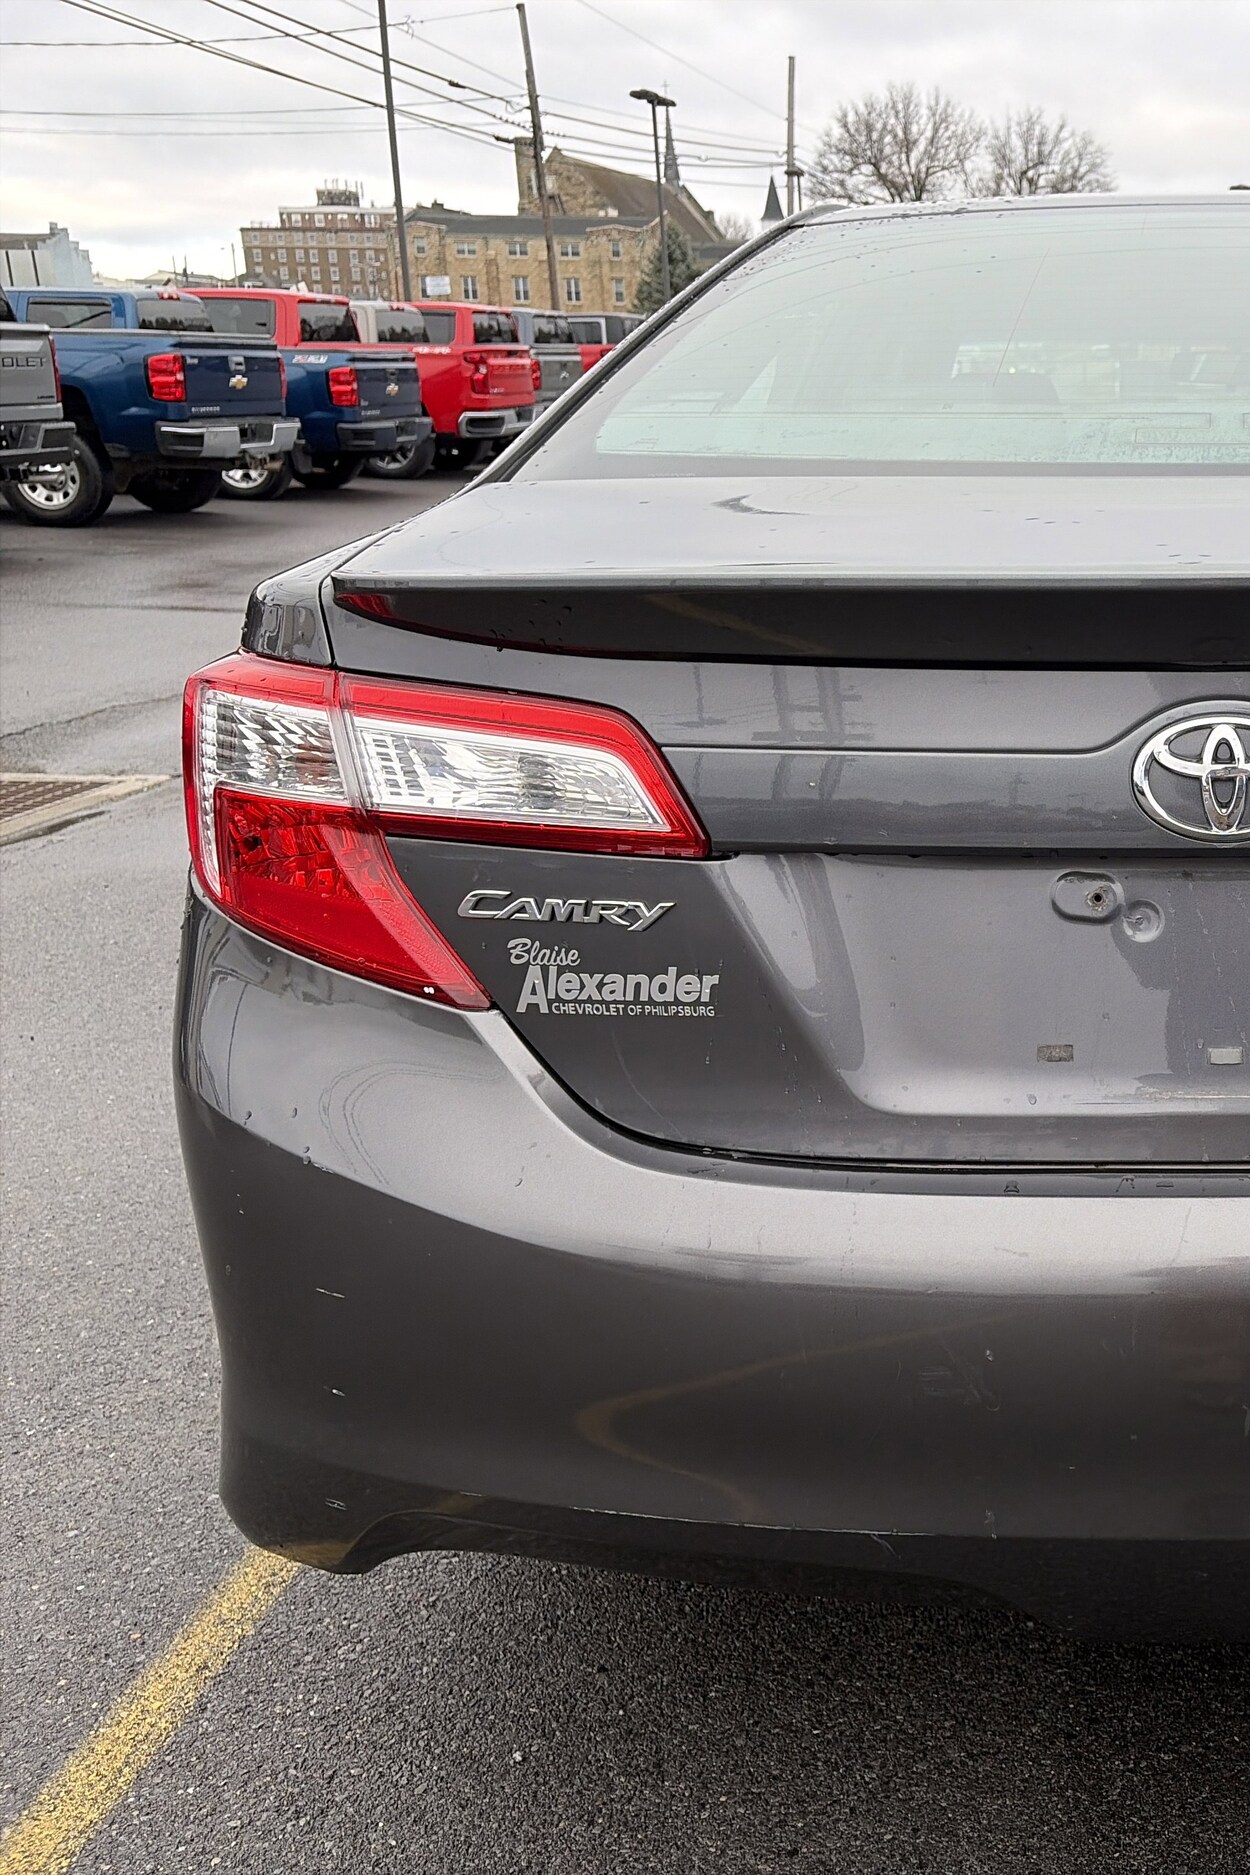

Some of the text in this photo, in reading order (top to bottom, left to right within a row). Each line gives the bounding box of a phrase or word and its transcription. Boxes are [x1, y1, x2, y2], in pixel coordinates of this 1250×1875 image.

[457, 889, 677, 932] CAMRY
[506, 937, 581, 966] Blaise
[516, 965, 720, 1014] Alexander
[551, 1003, 715, 1018] CHEVROLET OF PHILIPSBURG
